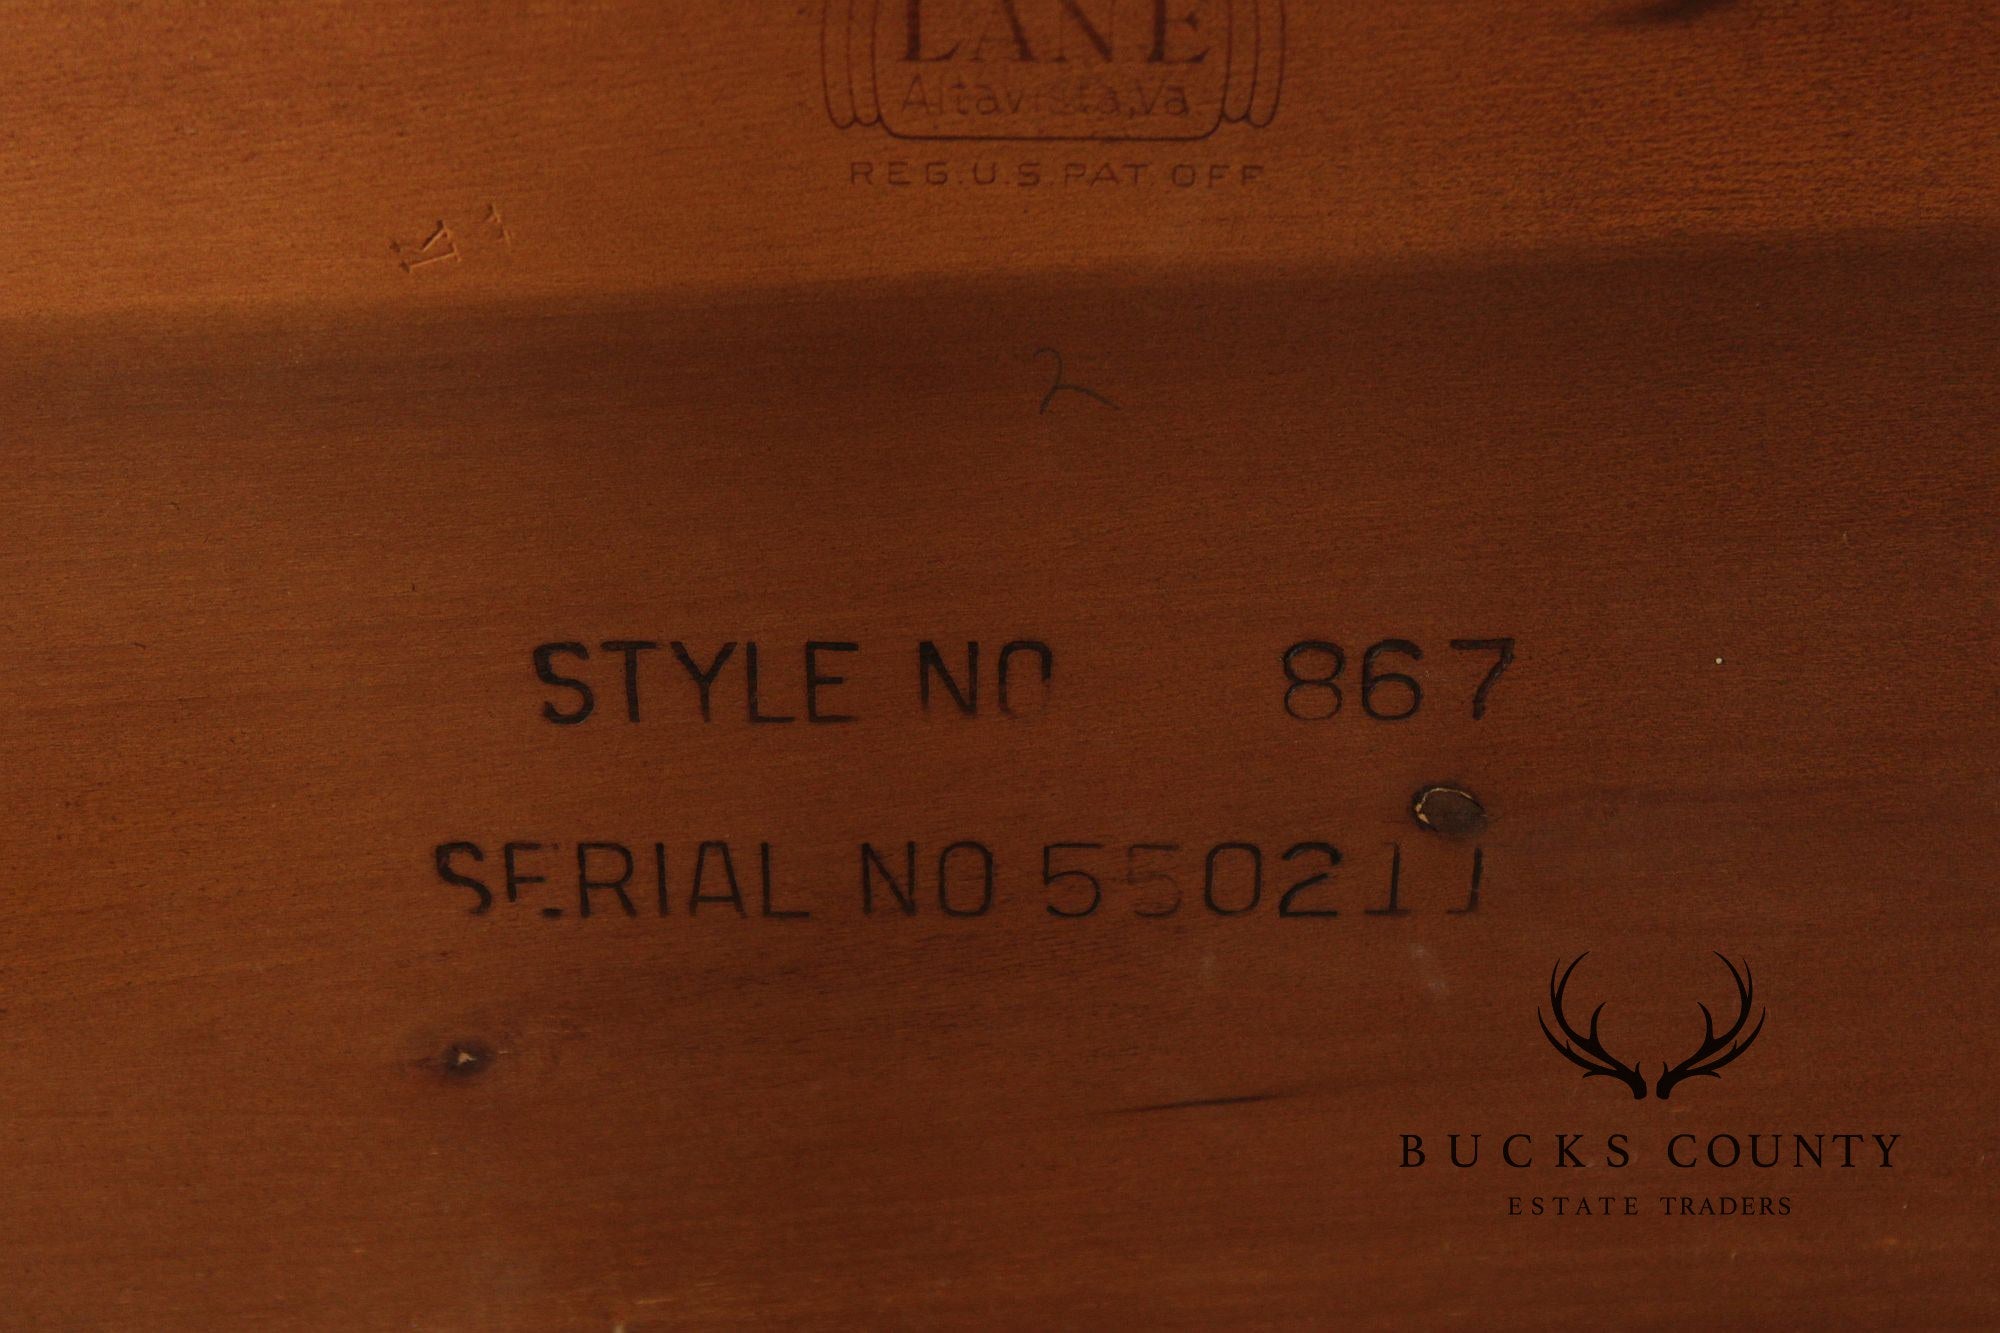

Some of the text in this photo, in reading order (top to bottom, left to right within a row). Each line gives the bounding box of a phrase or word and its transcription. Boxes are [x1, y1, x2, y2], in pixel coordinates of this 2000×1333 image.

[898, 0, 1209, 62] LANE
[1172, 163, 1265, 188] OFF
[532, 637, 1515, 724] STYLE NO 867
[434, 840, 1485, 920] SERIAL NO 550211
